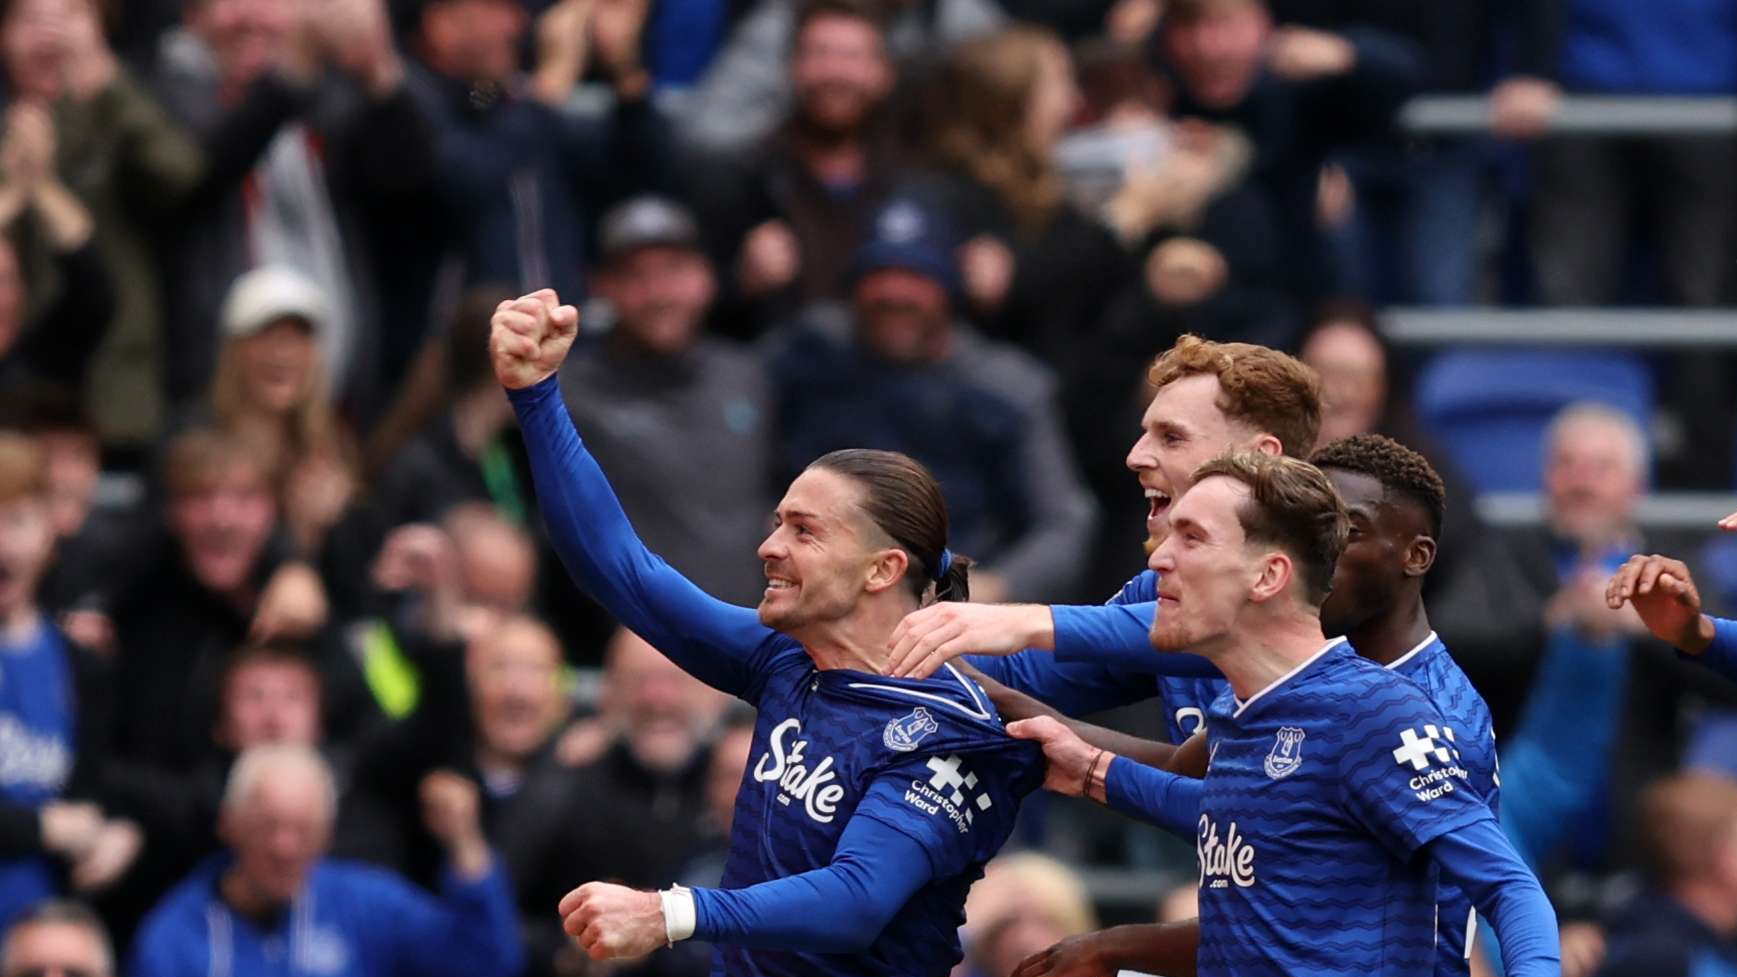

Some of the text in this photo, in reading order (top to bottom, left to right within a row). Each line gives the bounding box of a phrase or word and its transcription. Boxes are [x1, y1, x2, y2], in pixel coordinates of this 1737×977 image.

[754, 717, 844, 823] Stake
[1416, 780, 1454, 802] Ward
[904, 789, 940, 815] Ward
[911, 780, 969, 833] Christopher
[1197, 813, 1256, 888] Stake
